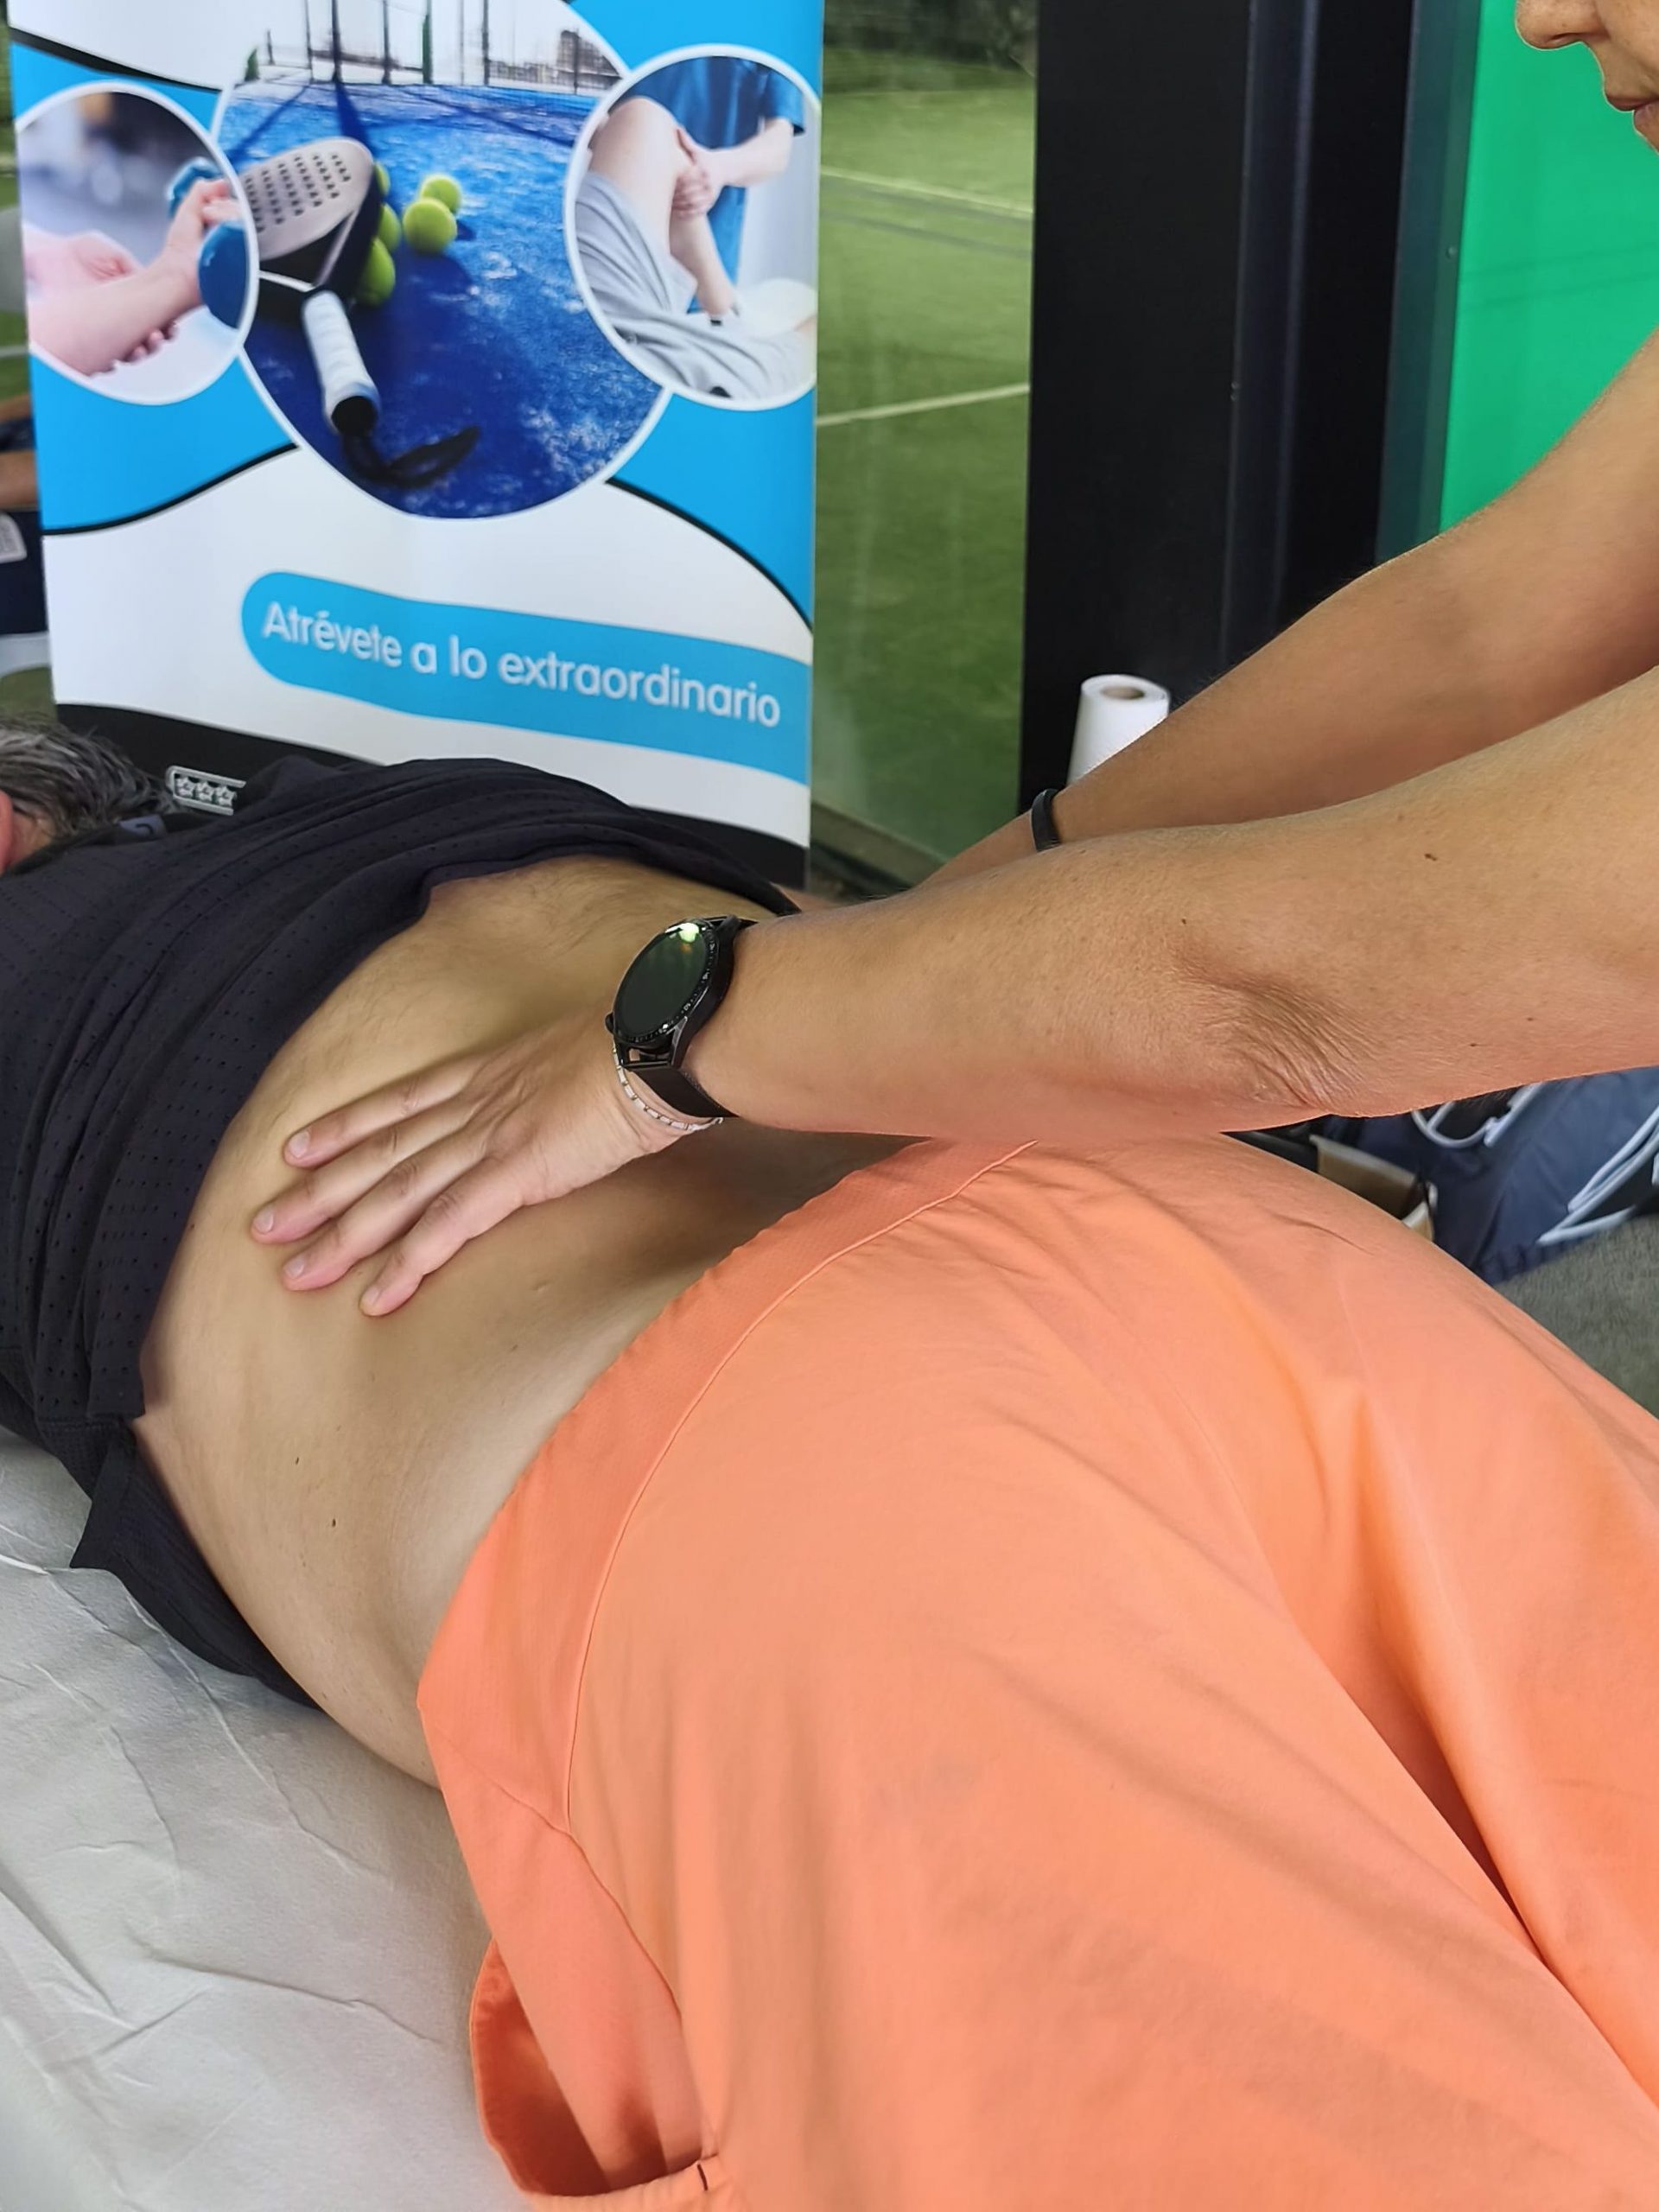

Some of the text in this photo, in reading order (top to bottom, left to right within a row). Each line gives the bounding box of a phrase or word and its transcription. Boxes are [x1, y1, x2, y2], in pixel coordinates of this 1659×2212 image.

[263, 601, 779, 728] Atrévete a lo extraordinario
